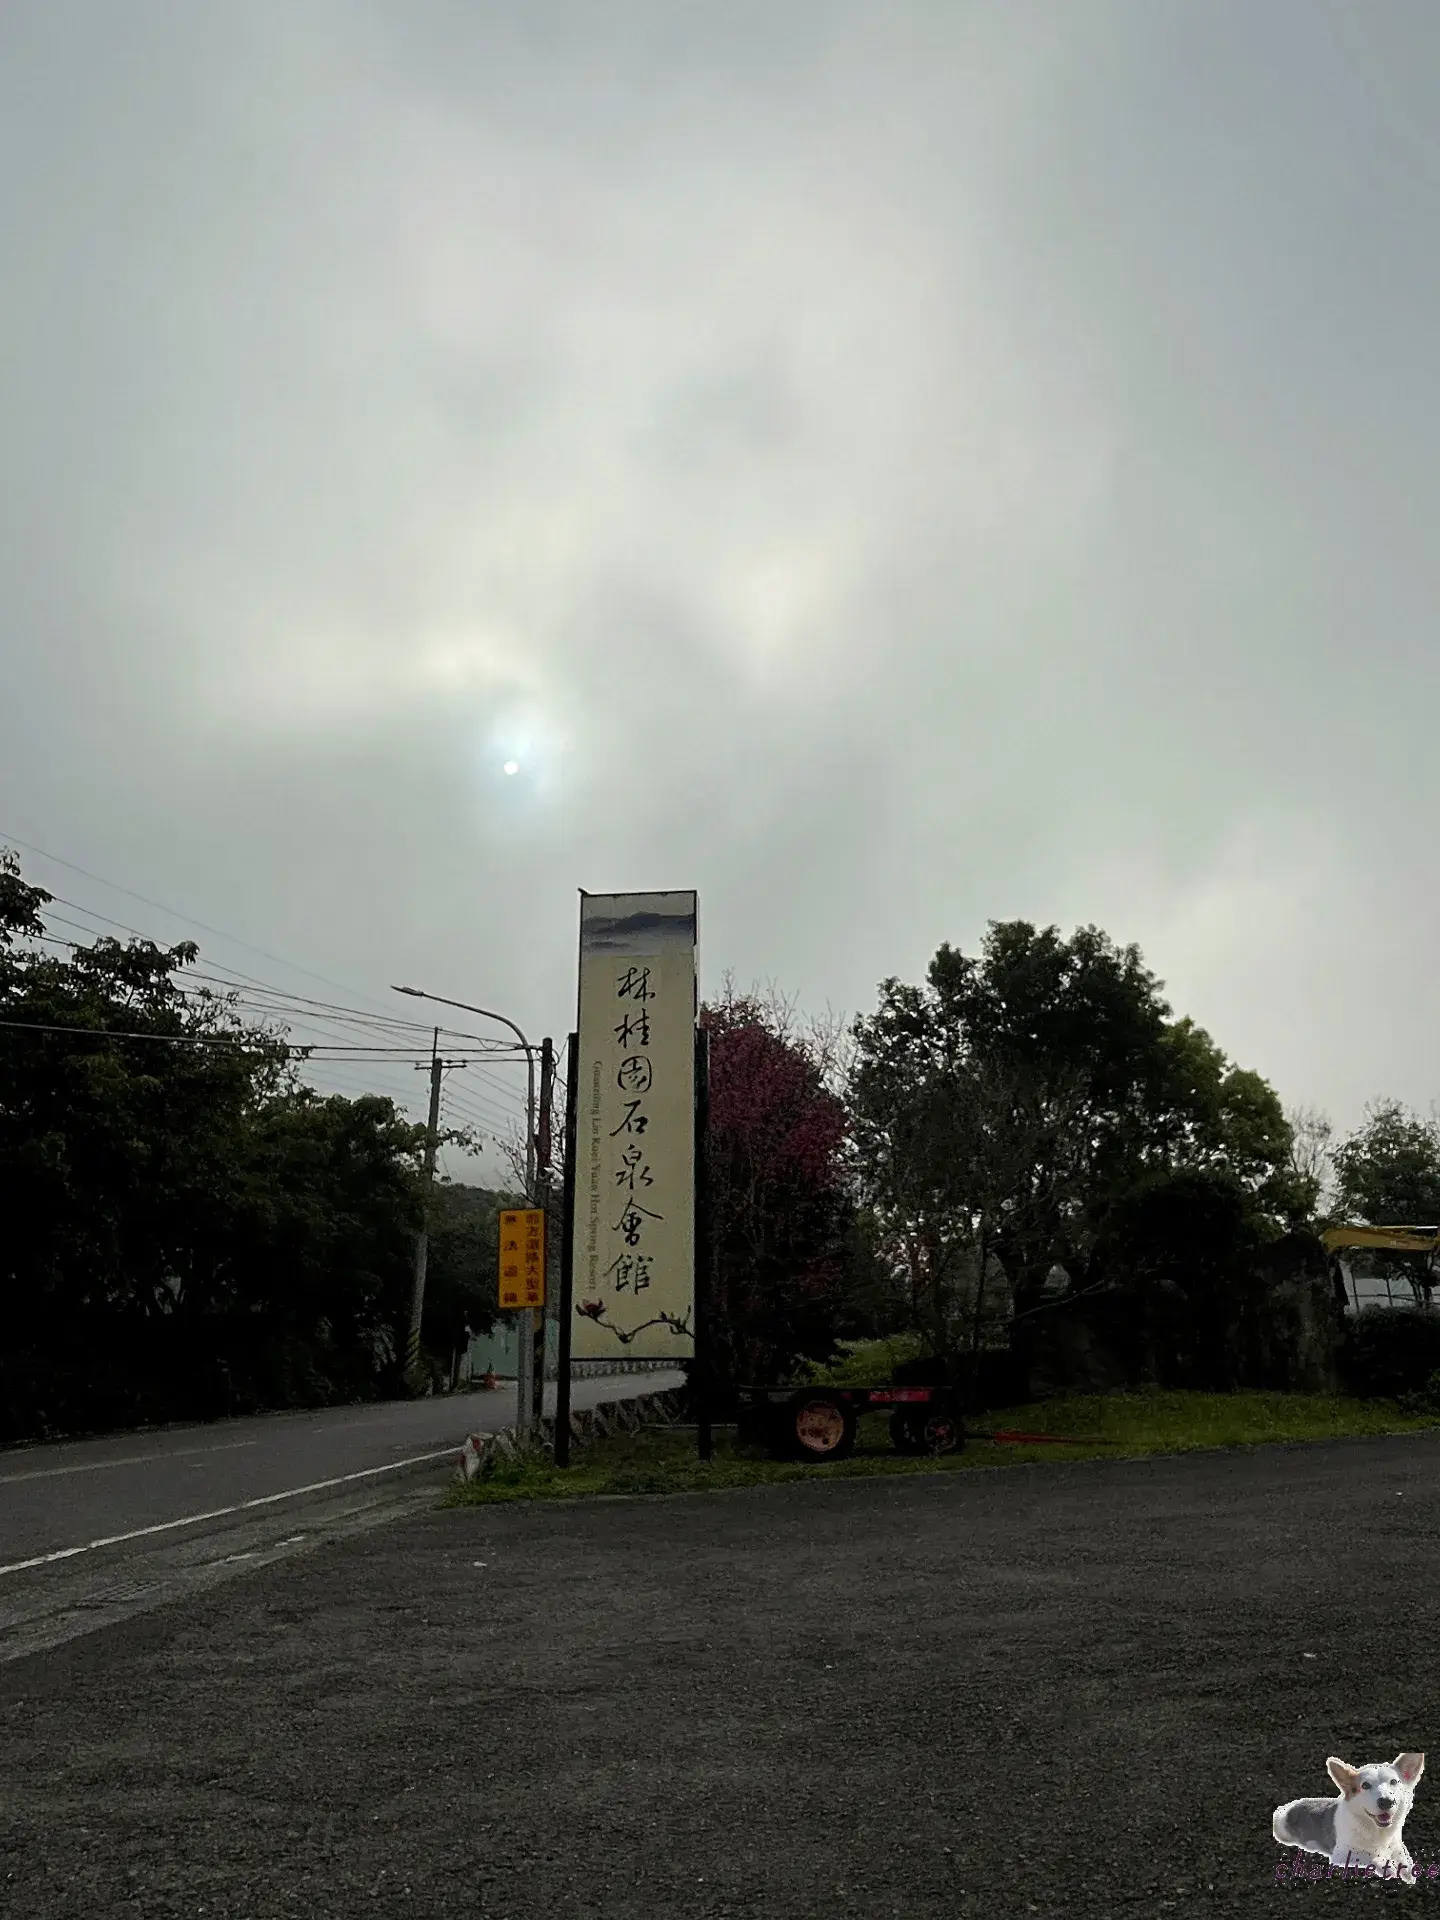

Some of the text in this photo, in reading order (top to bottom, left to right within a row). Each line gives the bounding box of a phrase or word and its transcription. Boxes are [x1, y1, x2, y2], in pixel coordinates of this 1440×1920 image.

[604, 967, 664, 1295] 林桂園石泉會館
[590, 1164, 602, 1191] Yuan
[590, 1194, 601, 1214] Hot
[587, 1216, 600, 1251] Spring
[589, 1254, 599, 1292] Resort
